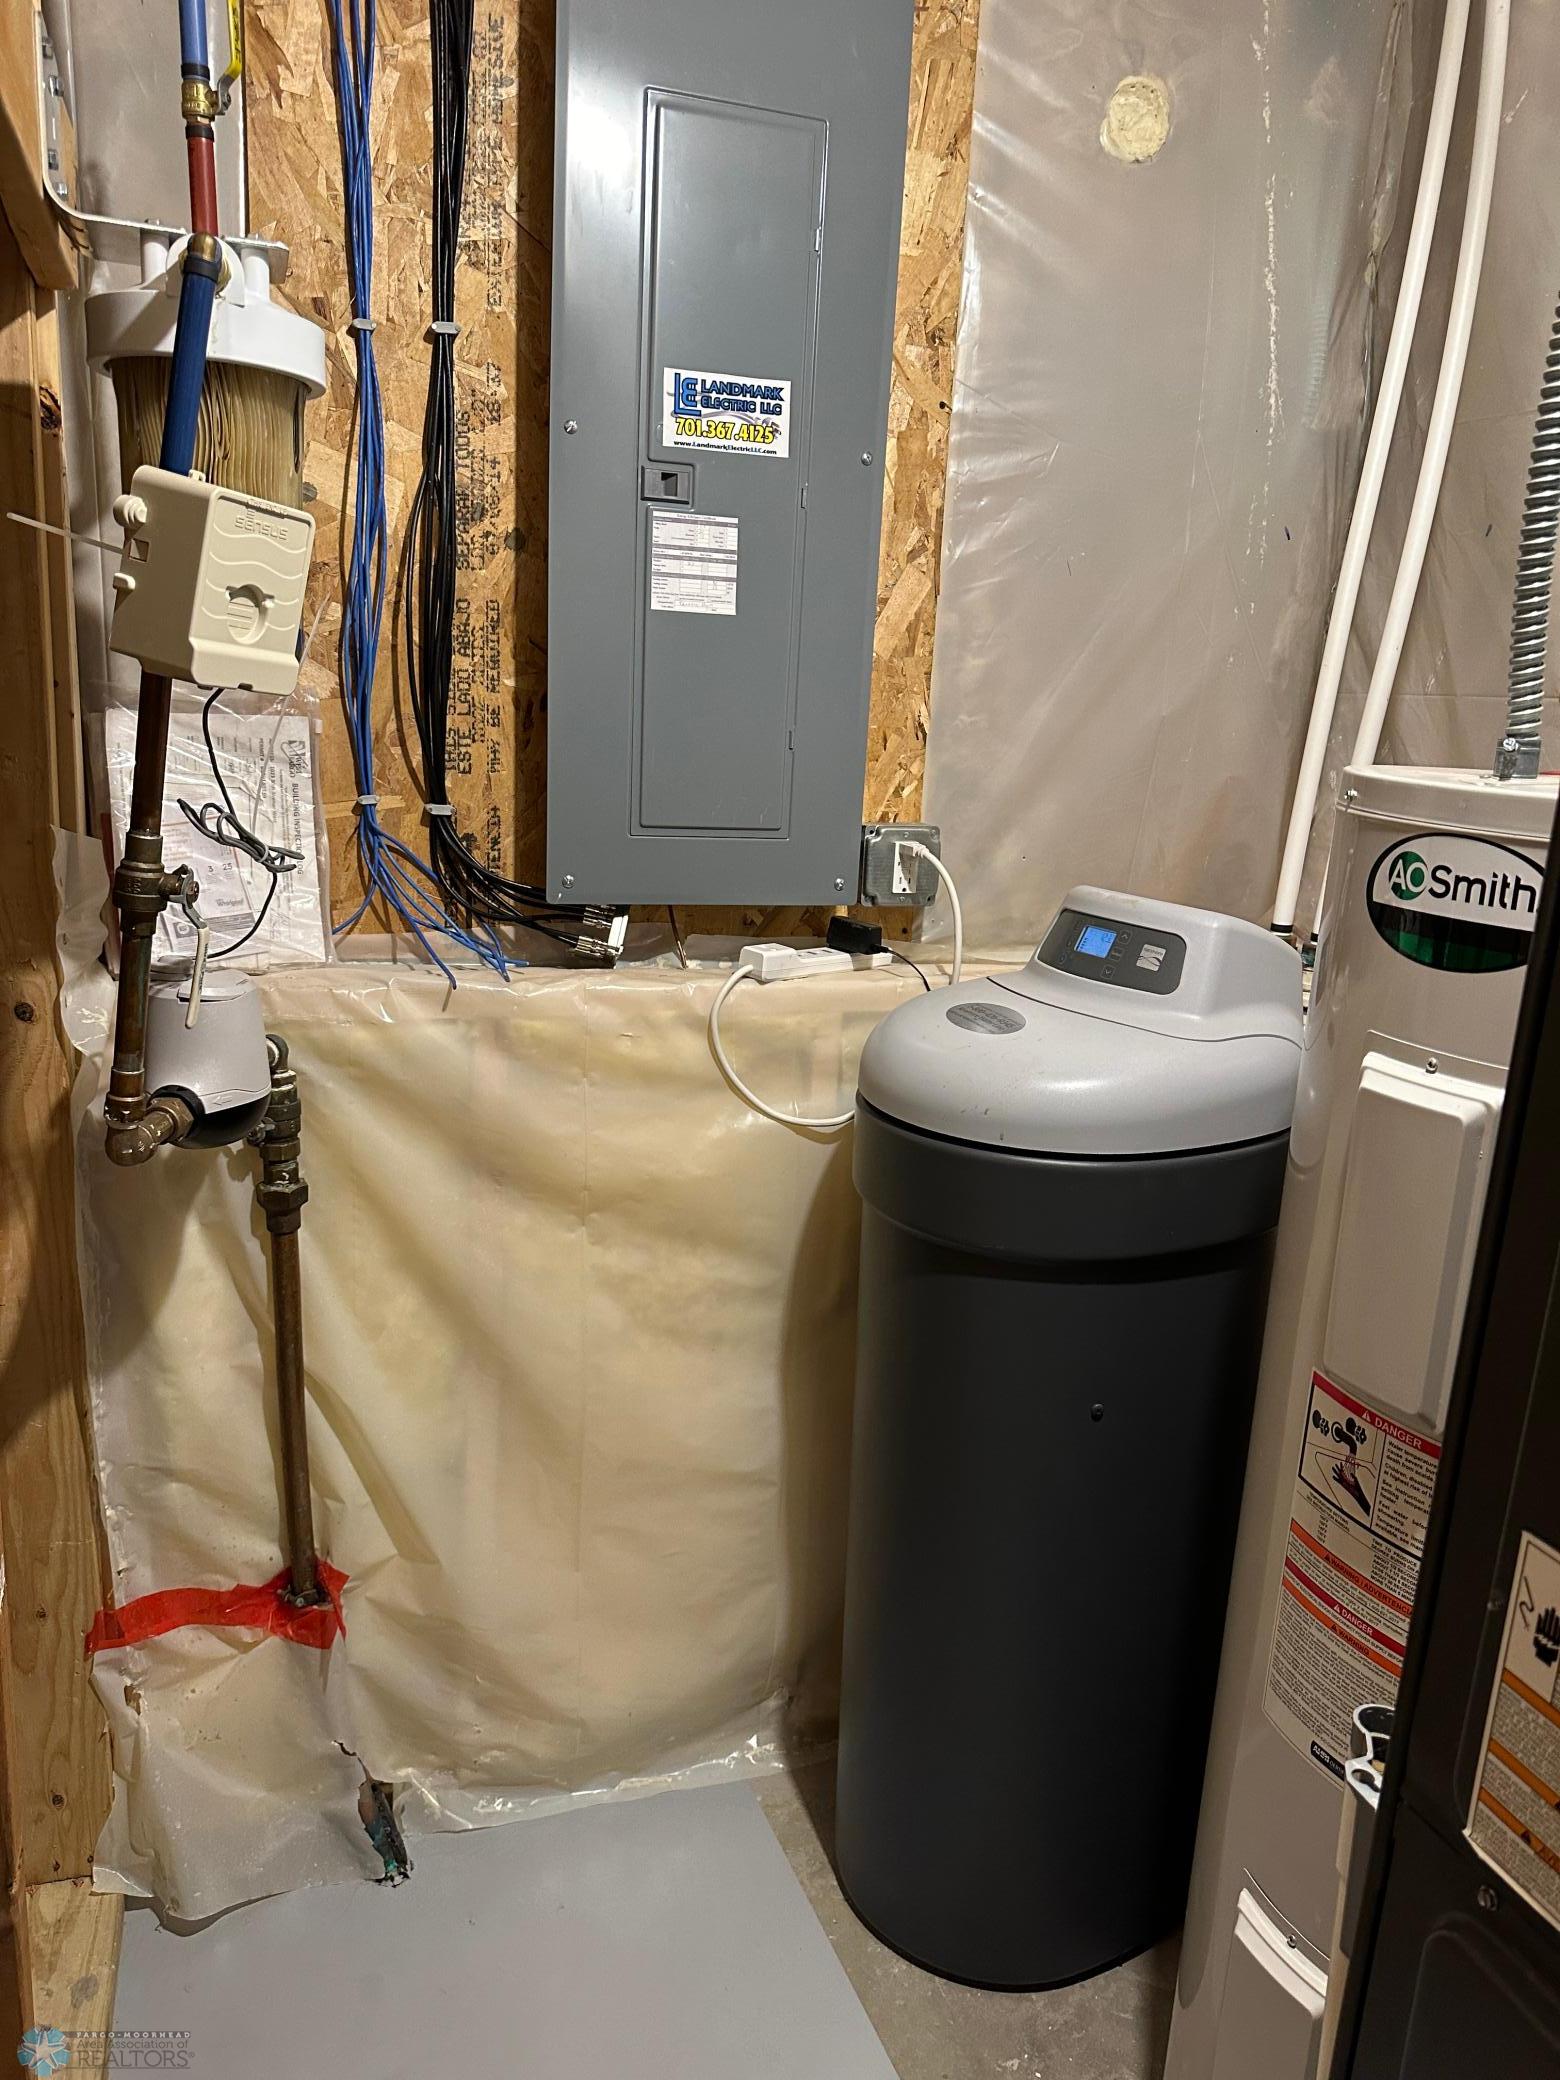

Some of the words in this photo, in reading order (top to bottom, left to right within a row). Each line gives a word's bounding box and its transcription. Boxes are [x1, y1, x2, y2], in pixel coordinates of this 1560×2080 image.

[701, 379, 784, 401] LANDMARK
[701, 397, 756, 413] ELECTRIC
[760, 402, 782, 415] LLC
[675, 417, 774, 444] 701.367.4125
[456, 598, 471, 658] ABAJO
[456, 667, 471, 717] LADO
[456, 727, 472, 775] ESTE
[292, 818, 304, 857] INSPECTI
[1428, 864, 1537, 914] Smith
[1375, 1417, 1422, 1450] DANGER
[1341, 1610, 1373, 1636] DANGER
